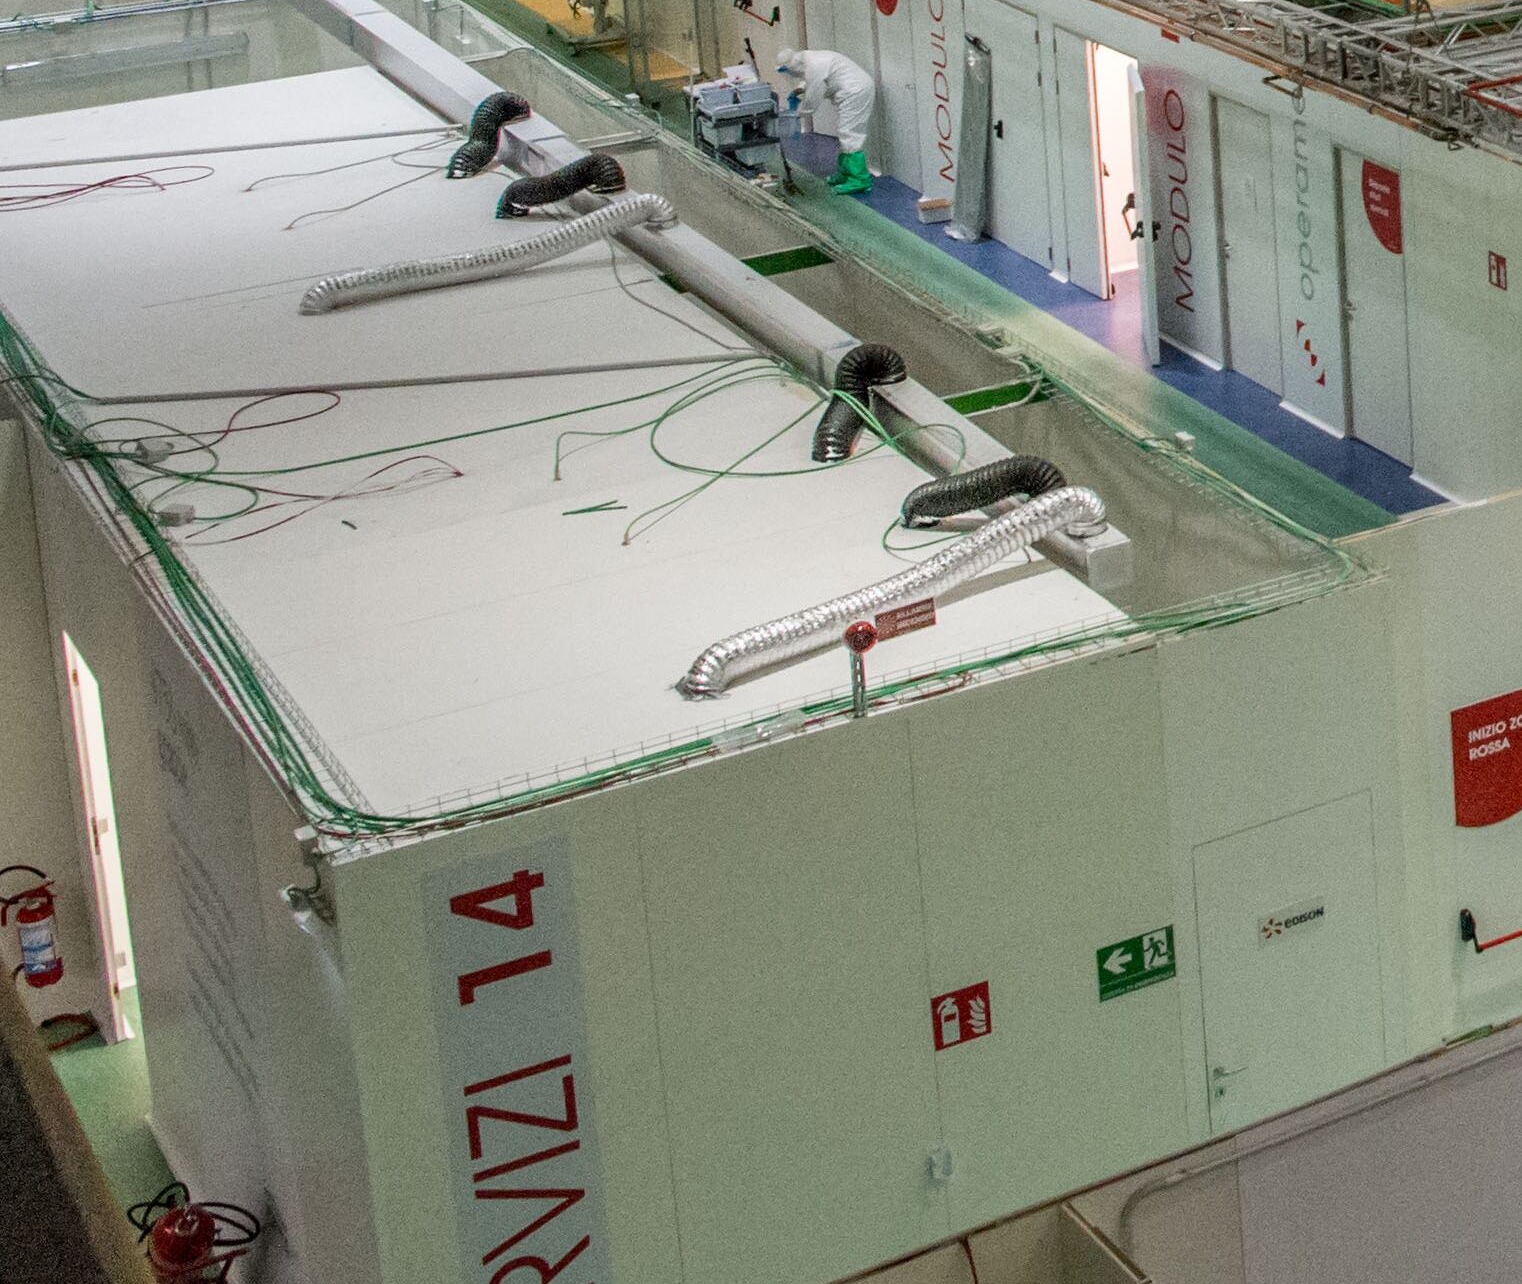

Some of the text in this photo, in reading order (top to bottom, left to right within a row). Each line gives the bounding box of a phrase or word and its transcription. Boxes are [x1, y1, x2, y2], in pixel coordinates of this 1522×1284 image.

[1164, 88, 1195, 314] MODULO
[1467, 720, 1507, 744] INIZIO
[1468, 736, 1511, 762] ROSSA
[448, 868, 553, 1007] 14
